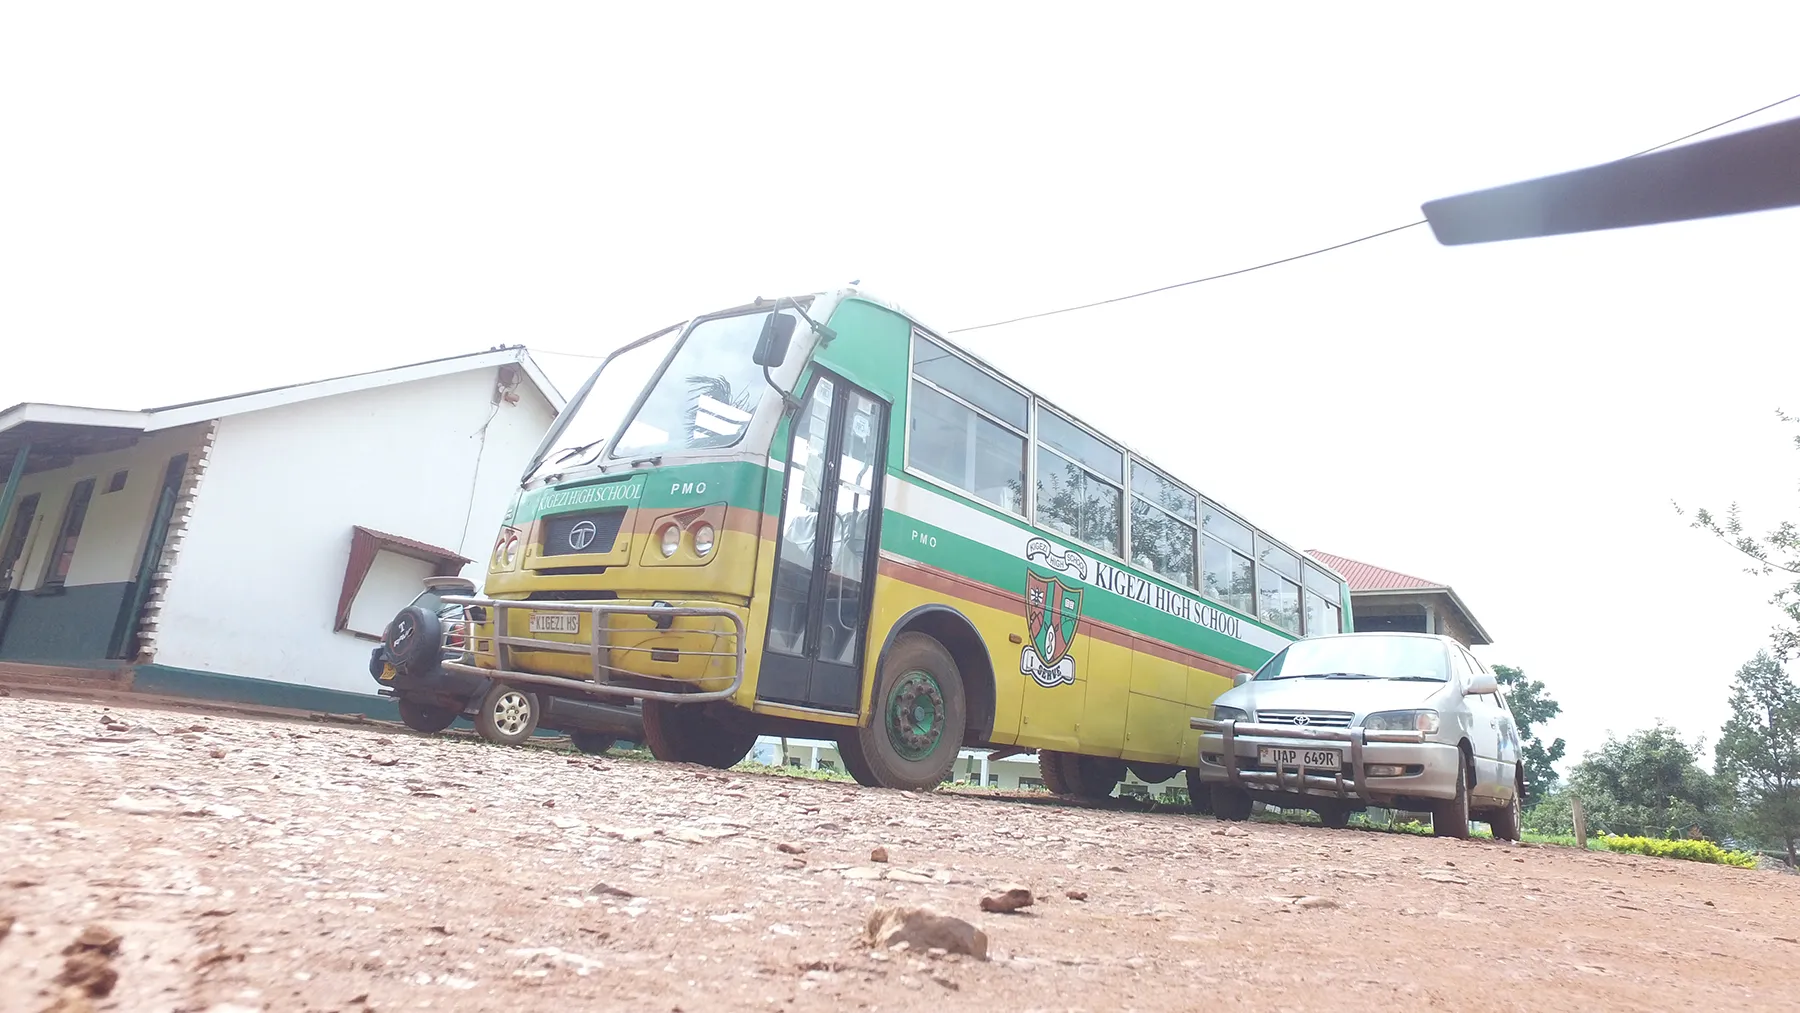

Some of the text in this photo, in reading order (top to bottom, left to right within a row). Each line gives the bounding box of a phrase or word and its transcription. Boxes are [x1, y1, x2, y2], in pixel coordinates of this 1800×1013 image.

[538, 484, 642, 511] KIGEZI HIGH SCHOOL
[670, 482, 707, 495] PMO
[911, 529, 937, 548] PMO
[1029, 542, 1085, 573] KIGEZI HIGH SCHOOL
[1095, 562, 1243, 640] KIGEZI HIGH SCHOOL
[536, 616, 577, 631] KIGEZI HS
[1037, 664, 1062, 681] SERVE
[1273, 749, 1334, 766] UAP 649R
